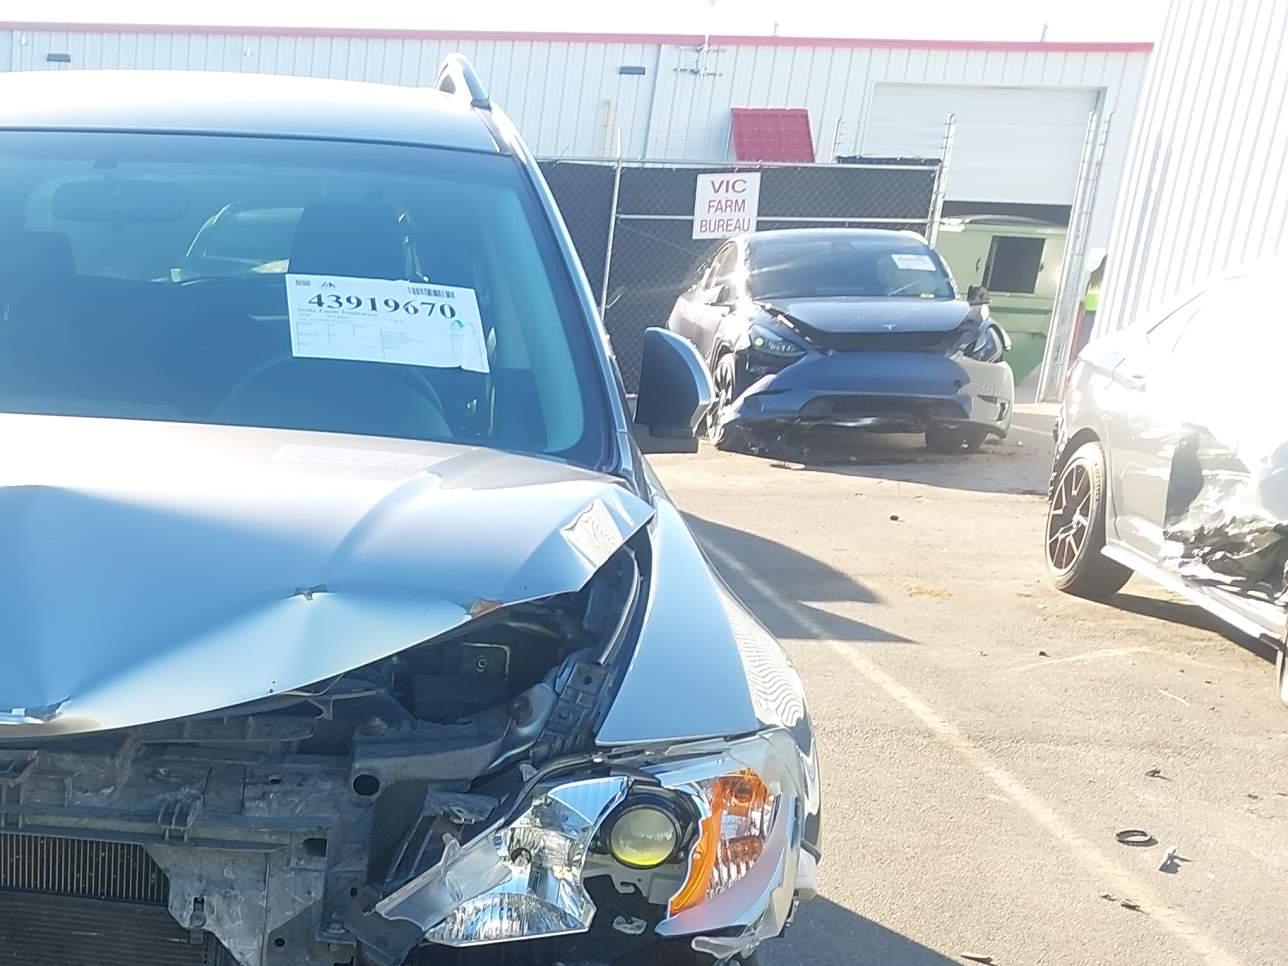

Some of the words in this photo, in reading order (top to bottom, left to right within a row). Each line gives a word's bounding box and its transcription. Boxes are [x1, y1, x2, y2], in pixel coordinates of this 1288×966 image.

[710, 179, 747, 194] VIC
[707, 198, 746, 214] FARM
[699, 217, 751, 233] BUREAU
[307, 292, 456, 320] 43919670
